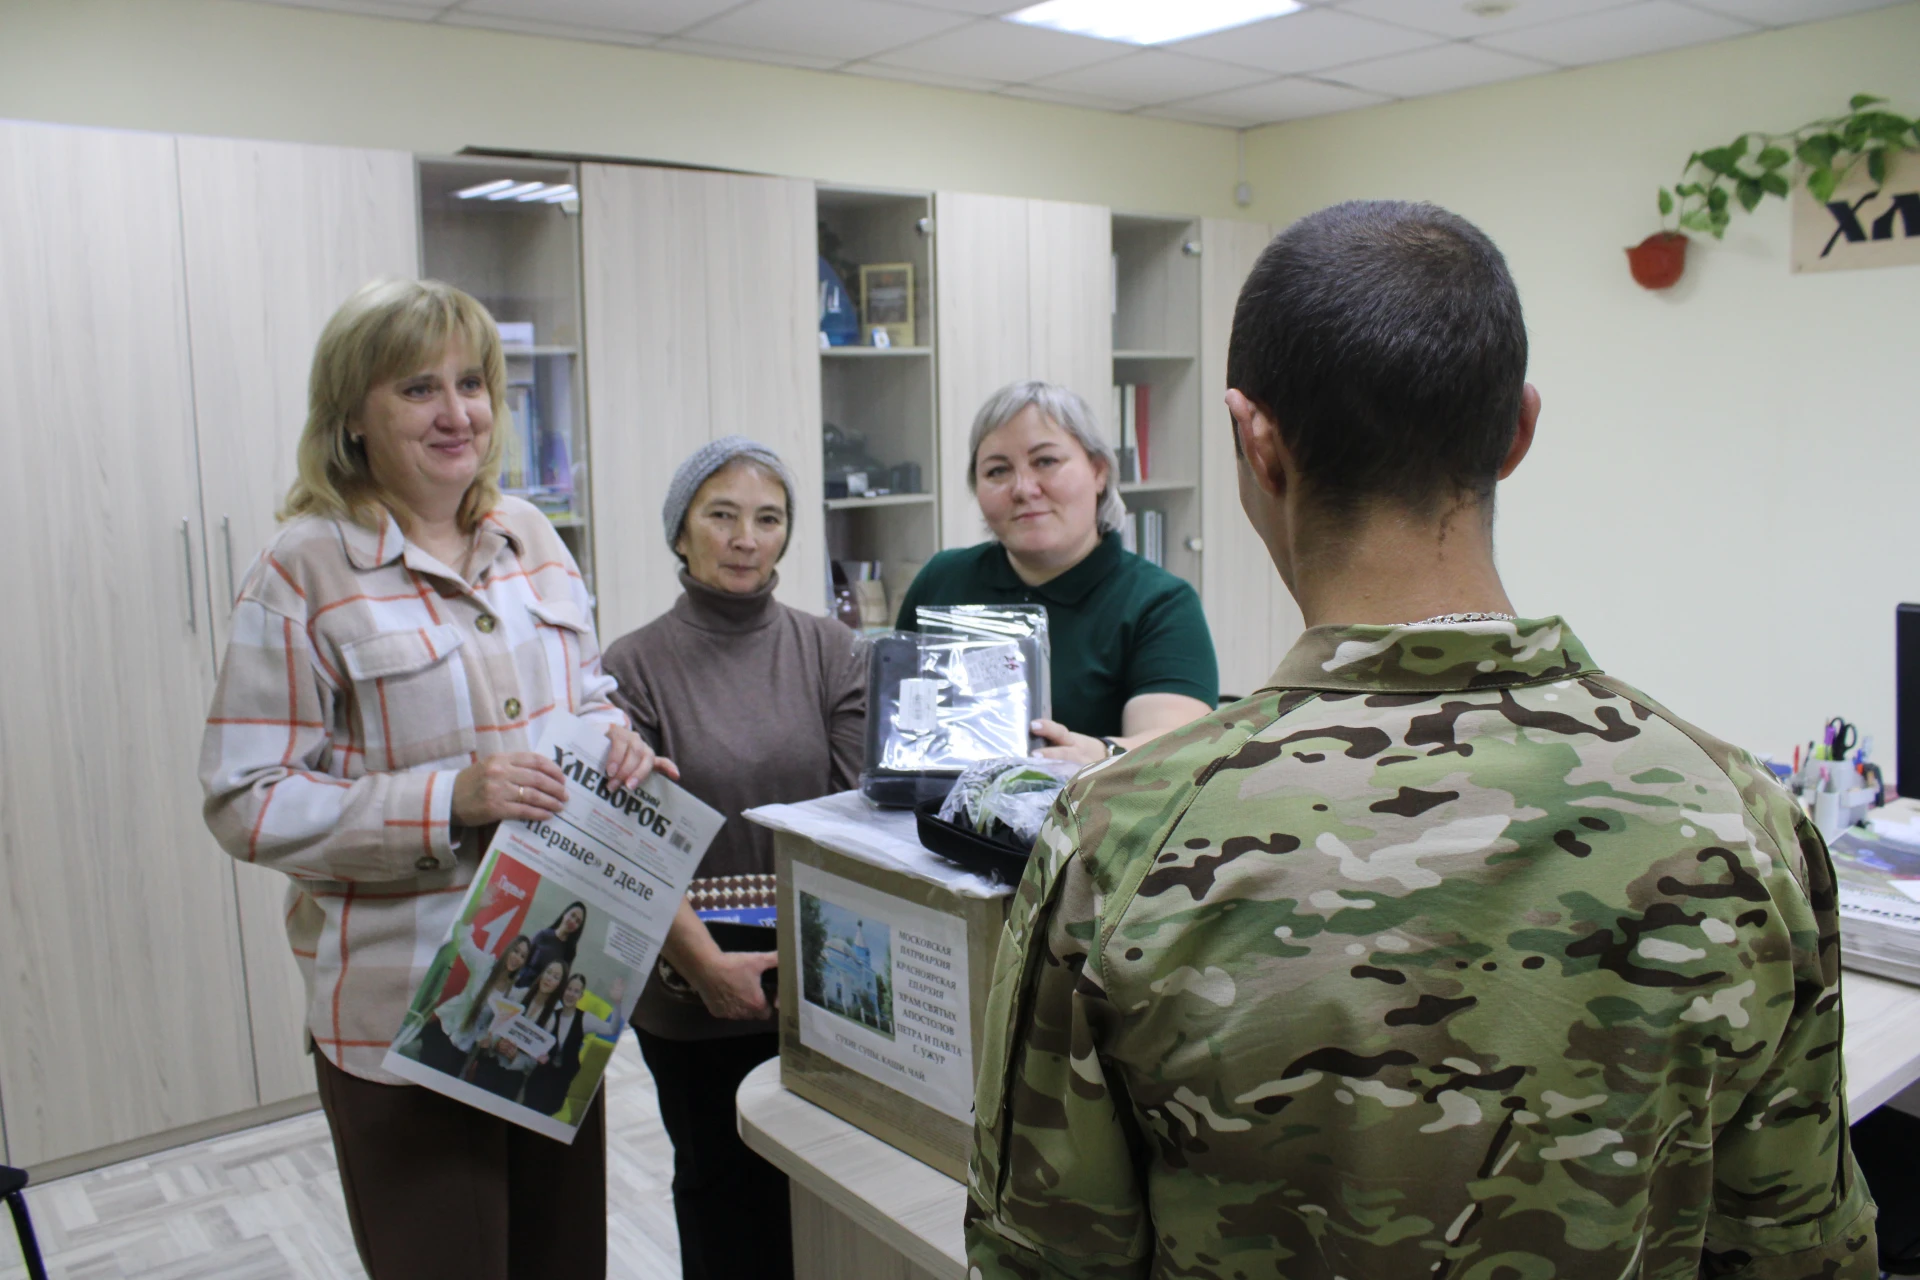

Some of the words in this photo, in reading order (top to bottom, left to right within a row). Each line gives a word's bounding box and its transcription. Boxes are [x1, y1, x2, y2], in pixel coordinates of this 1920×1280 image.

[520, 816, 603, 869] Первые»
[603, 862, 616, 878] в
[614, 870, 654, 901] деле
[899, 930, 952, 956] МОСКОВСКАЯ
[900, 945, 951, 971] ПАТРИАРХИЯ
[896, 960, 957, 990] КРАСНОЯРСКАЯ
[908, 979, 944, 1000] ЕПАРХИЯ
[898, 991, 921, 1008] ХРАМ
[922, 1001, 957, 1022] СВЯТЫХ
[902, 1008, 955, 1036] АПОСТОЛОВ
[897, 1023, 923, 1041] ПЕТРА
[924, 1033, 931, 1044] И
[932, 1037, 962, 1057] ПАВЛА
[920, 1047, 946, 1065] УЖУР
